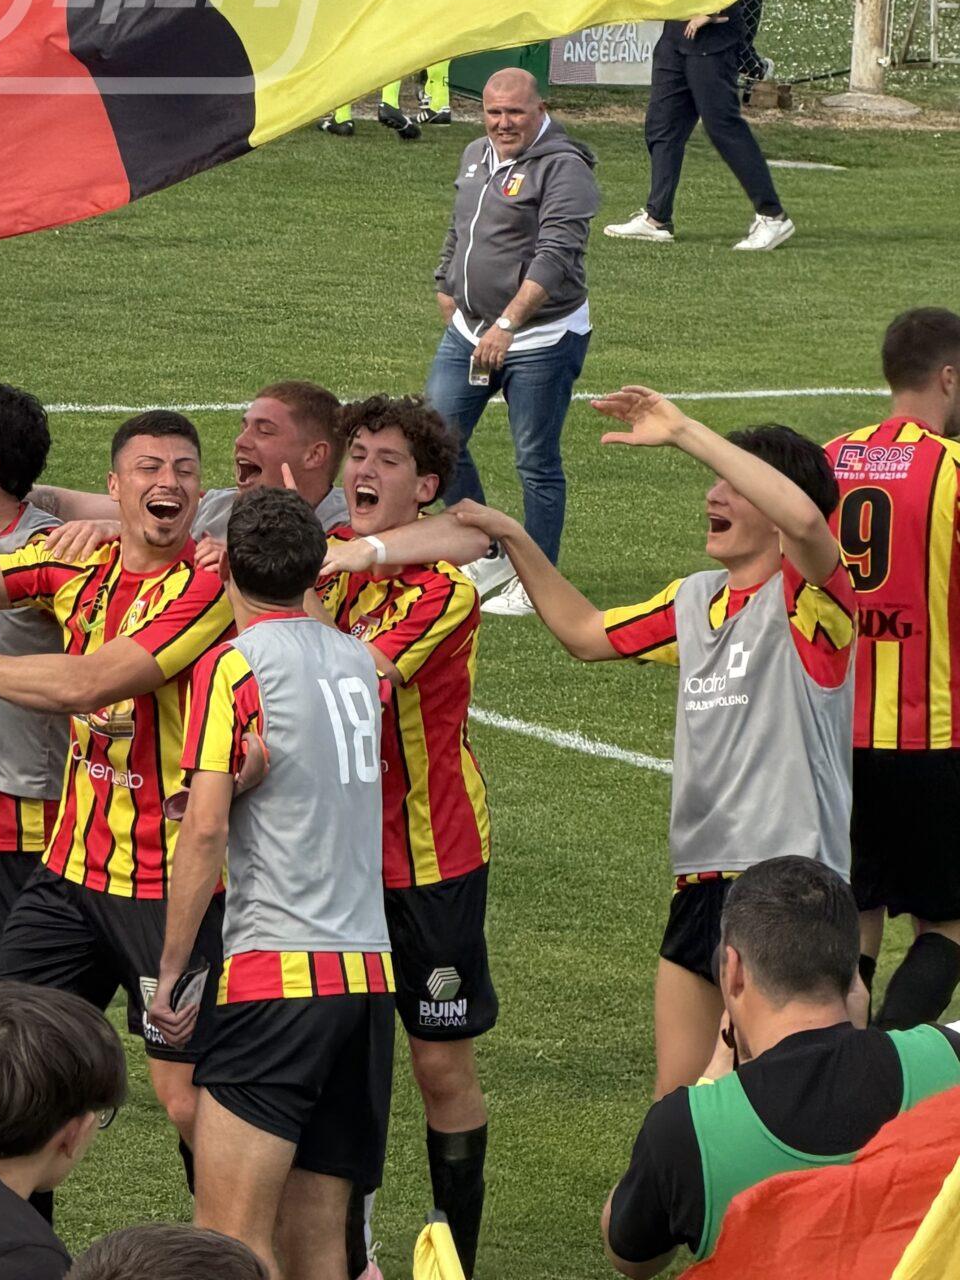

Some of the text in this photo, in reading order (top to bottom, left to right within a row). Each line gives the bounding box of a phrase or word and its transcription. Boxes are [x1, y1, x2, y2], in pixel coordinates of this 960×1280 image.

[563, 40, 653, 63] ANGELANA
[840, 486, 894, 594] 9
[317, 676, 380, 785] 18
[419, 999, 467, 1018] BUINI
